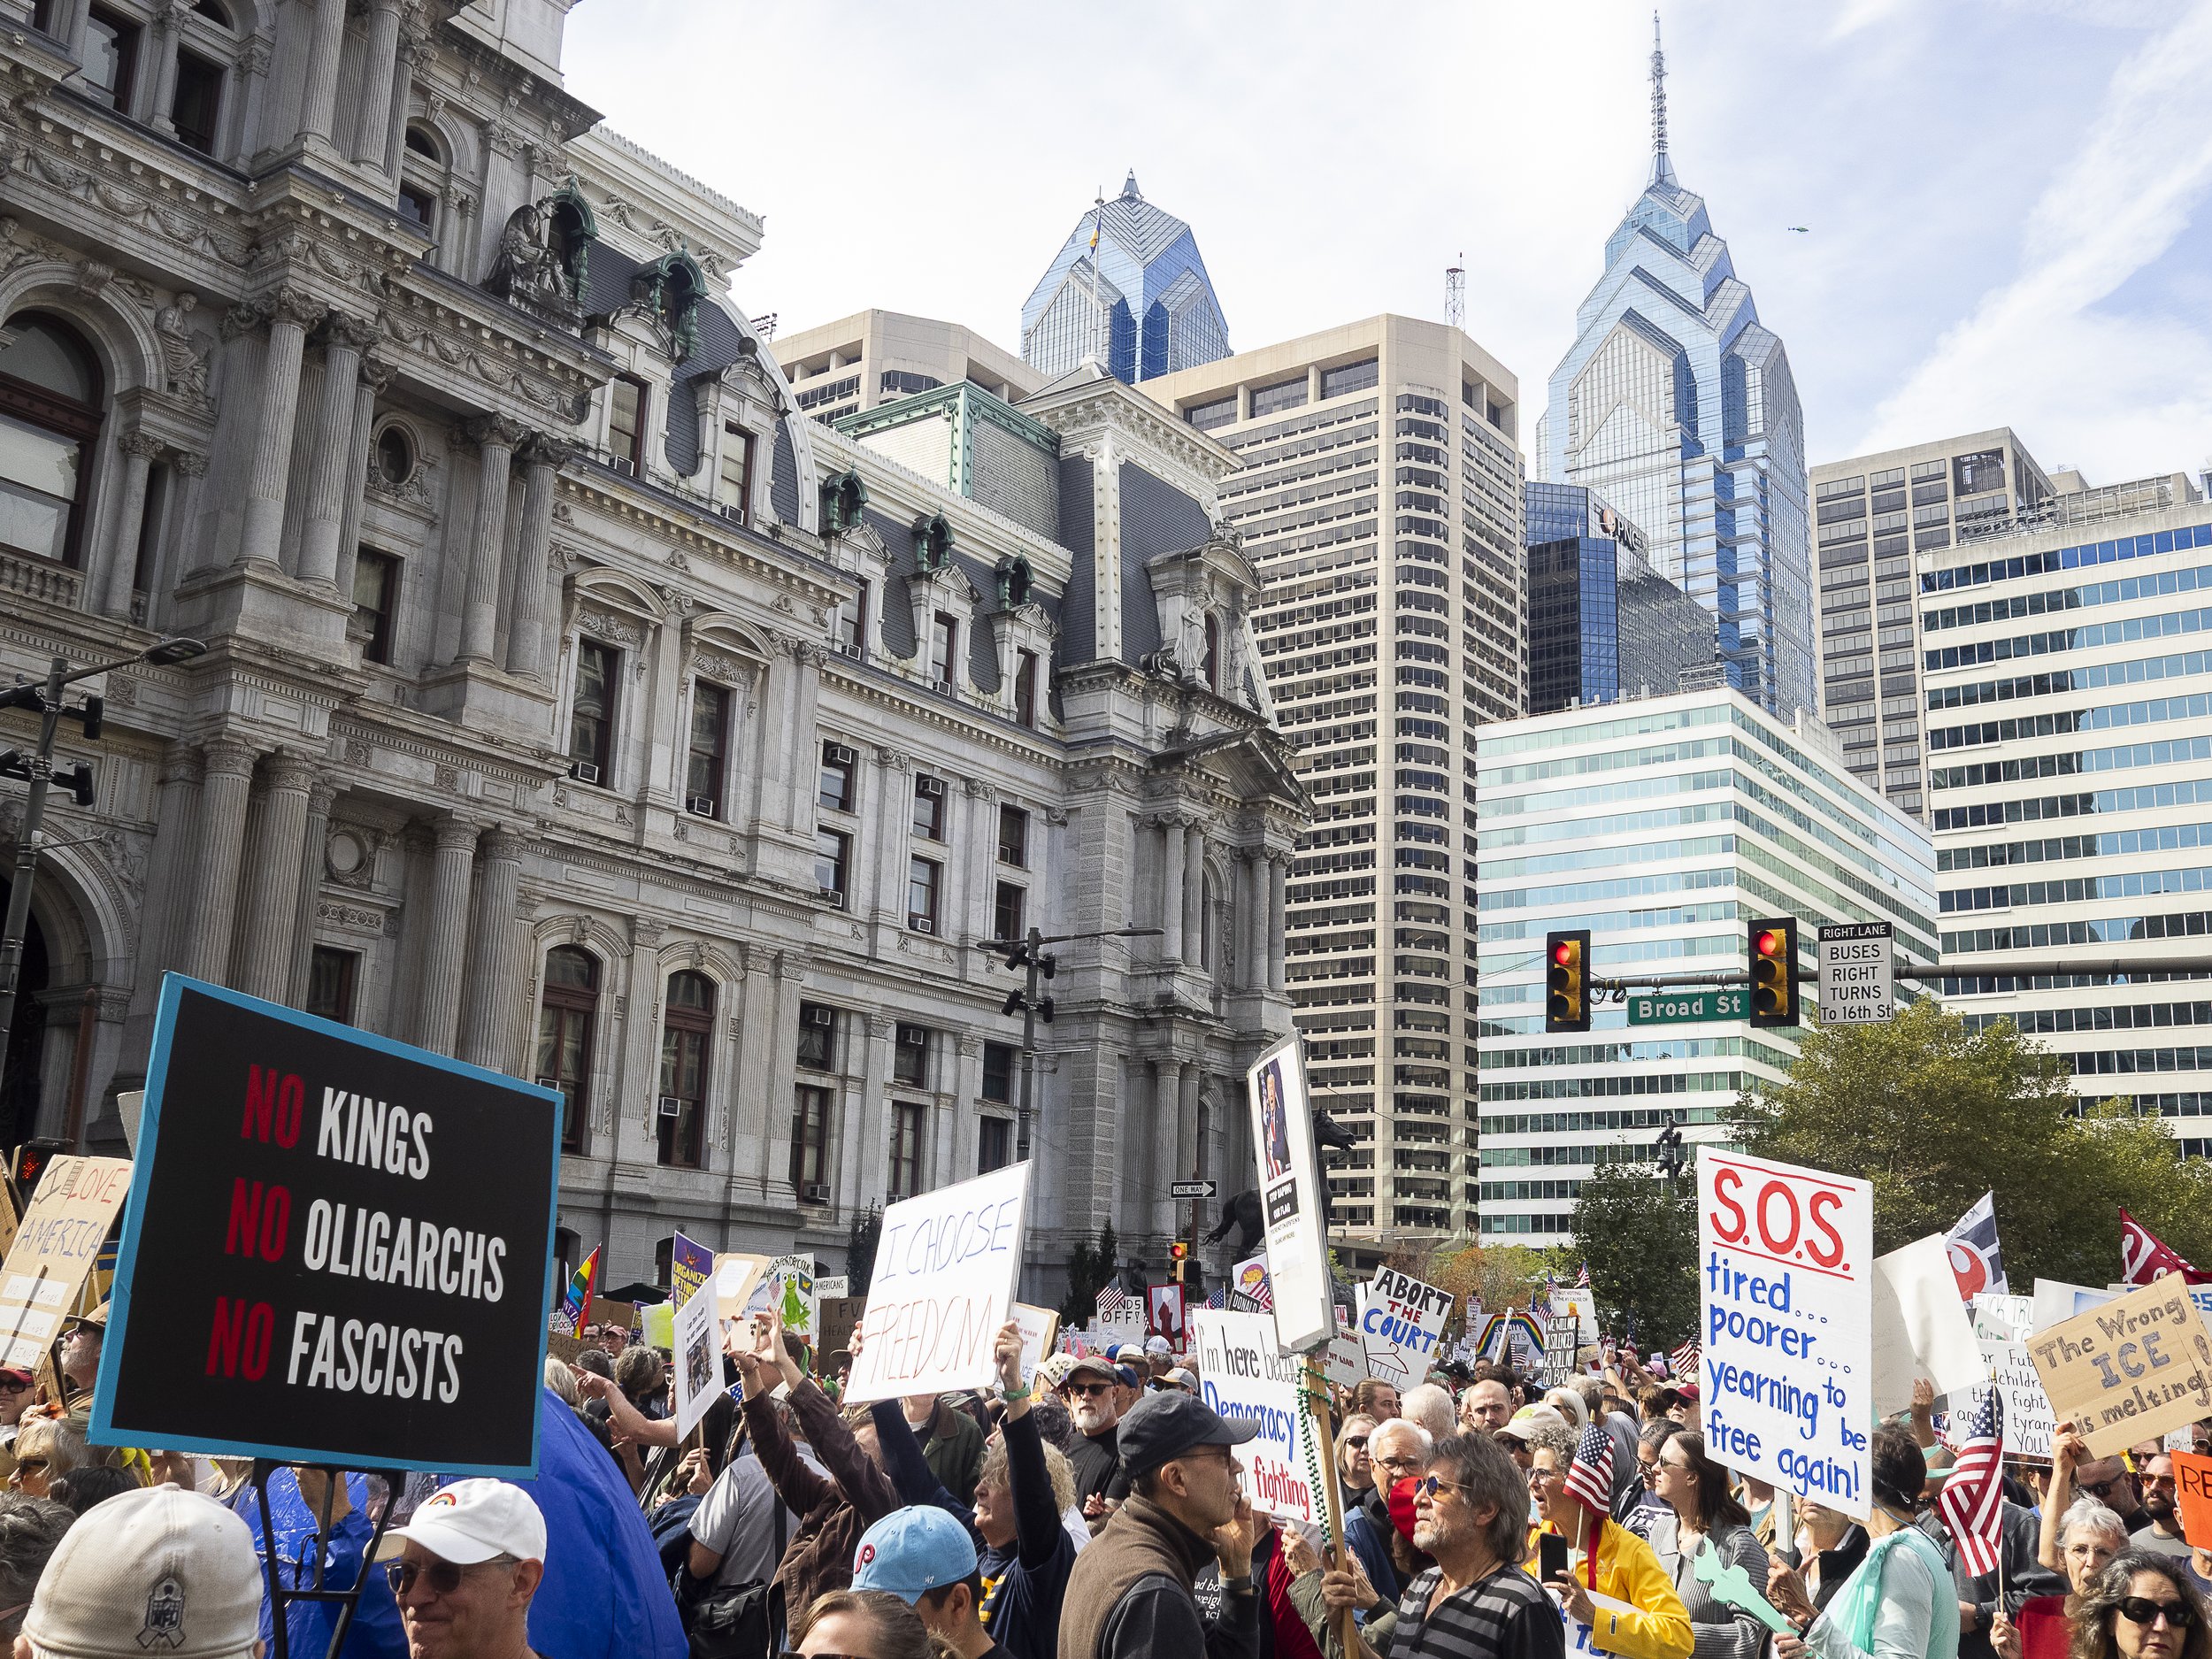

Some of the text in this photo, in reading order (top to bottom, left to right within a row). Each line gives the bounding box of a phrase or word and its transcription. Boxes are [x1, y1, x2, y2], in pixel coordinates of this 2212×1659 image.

[1824, 924, 1886, 938] RIGHT LANE
[1830, 944, 1881, 960] BUSES
[1832, 966, 1878, 981] RIGHT
[1639, 995, 1741, 1018] Broad St
[1831, 986, 1881, 1001] TURNS
[1821, 1003, 1893, 1020] To 16th St
[241, 1064, 433, 1179] NO KINGS
[67, 1166, 129, 1204] LOVE
[1709, 1167, 1851, 1271] S.O.S.
[15, 1217, 105, 1258] AMERICA
[226, 1178, 507, 1302] NO OLIGARCHS
[879, 1197, 1018, 1283] I CHOOSE
[673, 1260, 708, 1285] ORGANIZE
[673, 1274, 698, 1297] DETHRO
[815, 1279, 844, 1290] AMERICANS
[1233, 1294, 1257, 1313] DONALD
[1375, 1270, 1452, 1316] ABORT
[1387, 1300, 1423, 1324] THE
[1548, 1317, 1577, 1332] WE WILL NOT
[2011, 1297, 2033, 1325] TRU
[852, 1294, 993, 1388] FREEDOM
[1363, 1308, 1437, 1354] COURT
[1496, 1333, 1527, 1343] HRTS
[2035, 1336, 2094, 1370] The
[2096, 1296, 2186, 1341] Wrong
[205, 1296, 464, 1403] NO FASCISTS
[1197, 1323, 1301, 1384] I'm here becau
[1544, 1351, 1552, 1369] WE
[1552, 1351, 1565, 1368] WILL
[1565, 1350, 1575, 1367] NOT
[1981, 1348, 2034, 1368] ar Fut
[2092, 1331, 2170, 1389] ICE
[1543, 1369, 1553, 1386] GO
[1707, 1358, 1847, 1440] yearning to
[2012, 1390, 2047, 1413] fight
[1840, 1419, 1867, 1451] be
[2073, 1412, 2094, 1437] is
[1707, 1409, 1860, 1502] free again!
[2014, 1432, 2050, 1454] YOU!
[1254, 1455, 1310, 1521] fighting
[2181, 1464, 2212, 1499] RE
[855, 1544, 876, 1574] P
